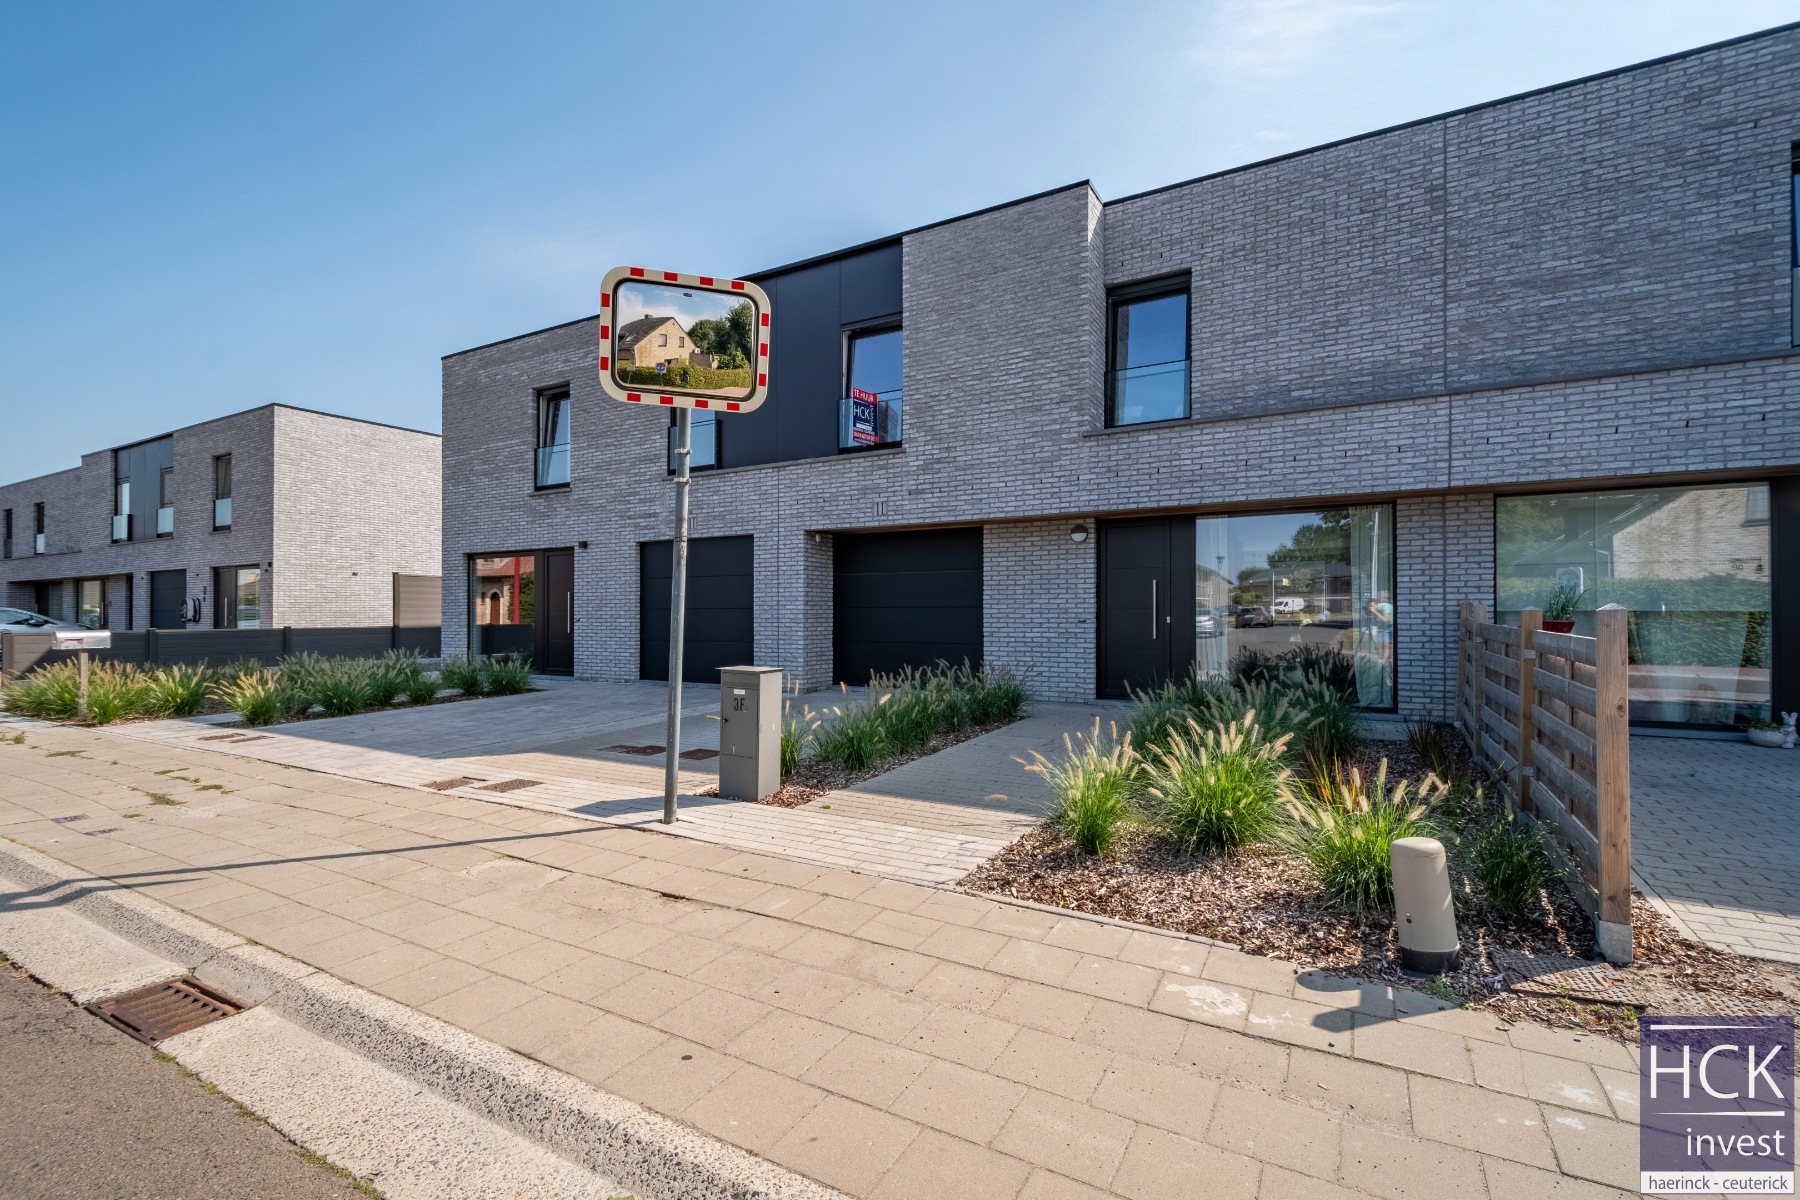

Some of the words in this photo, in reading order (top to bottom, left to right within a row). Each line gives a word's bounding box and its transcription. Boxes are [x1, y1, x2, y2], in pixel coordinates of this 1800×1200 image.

[854, 389, 860, 398] TE
[860, 392, 874, 402] HUUR
[854, 404, 870, 420] HCK
